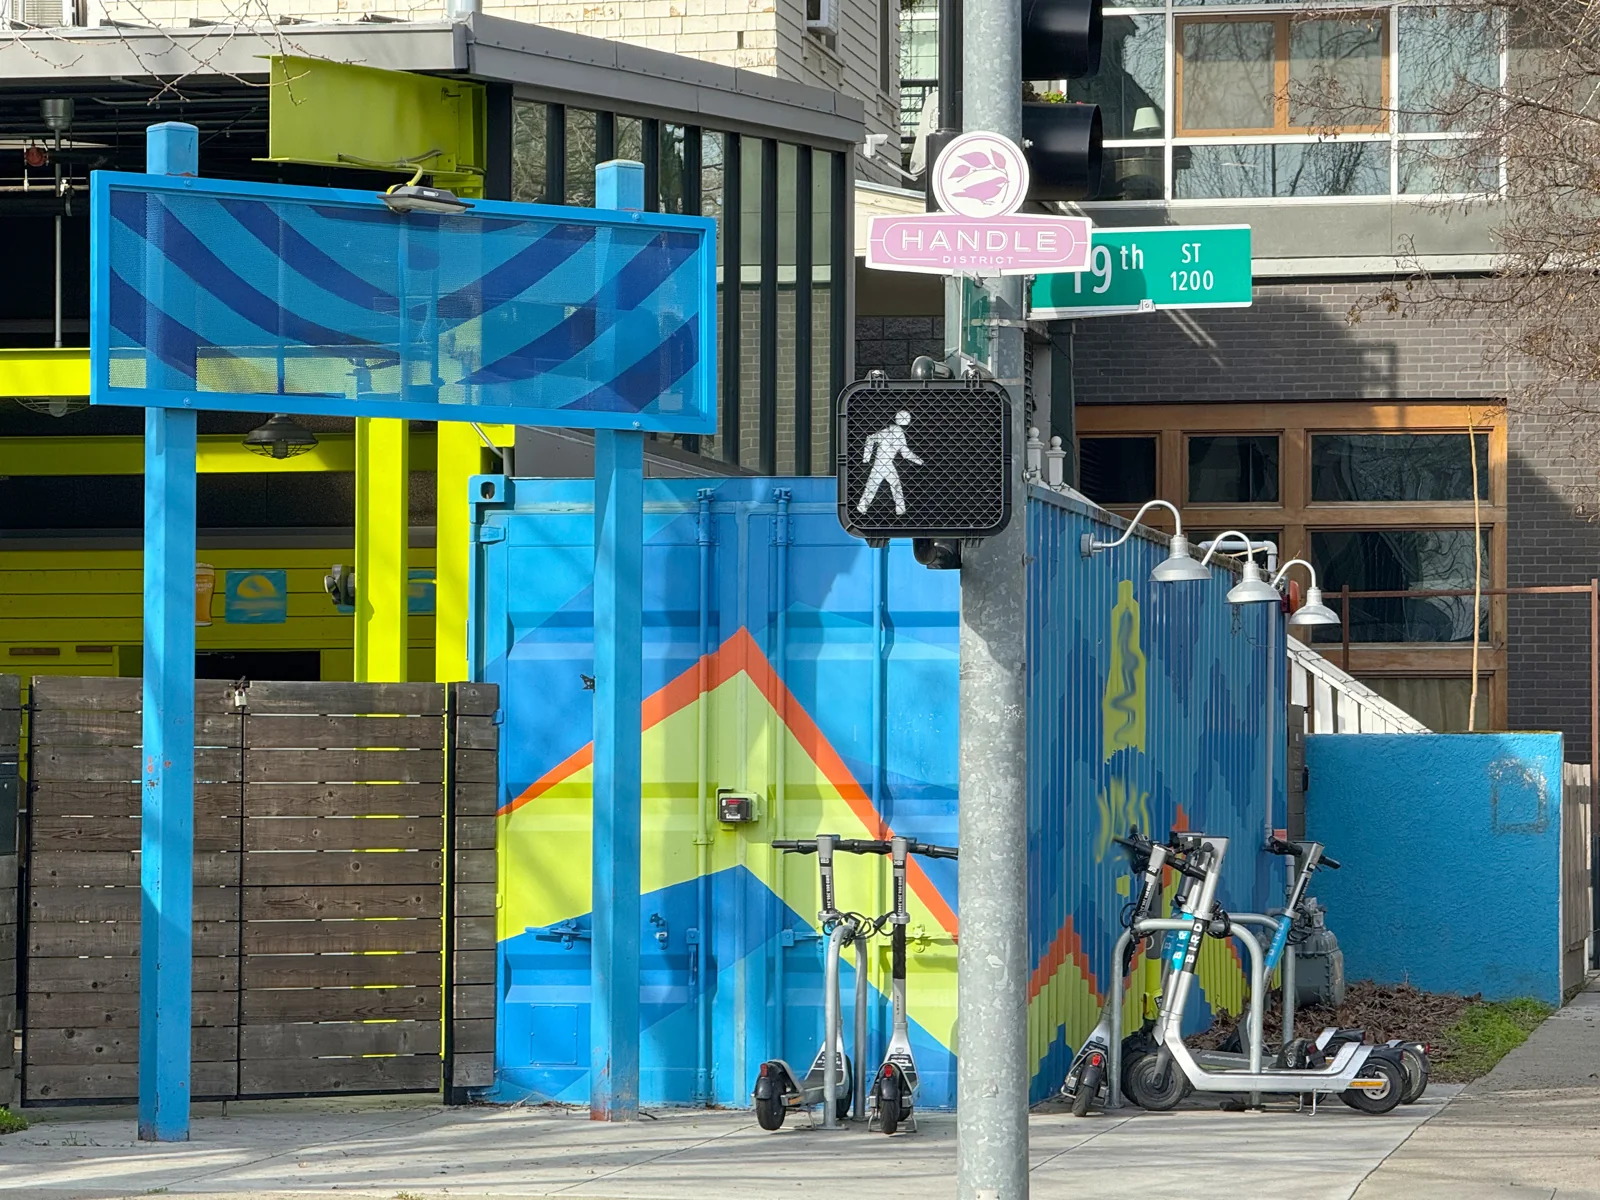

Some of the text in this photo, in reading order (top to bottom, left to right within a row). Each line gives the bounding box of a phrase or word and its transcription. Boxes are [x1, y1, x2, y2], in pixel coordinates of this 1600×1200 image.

[901, 228, 1058, 254] HANDLE
[1181, 243, 1202, 264] ST
[942, 255, 1014, 266] DISTRICT
[1170, 269, 1214, 291] 1200
[1172, 930, 1188, 960] BIR
[1185, 922, 1203, 963] BIRD
[1268, 923, 1285, 956] BIRD
